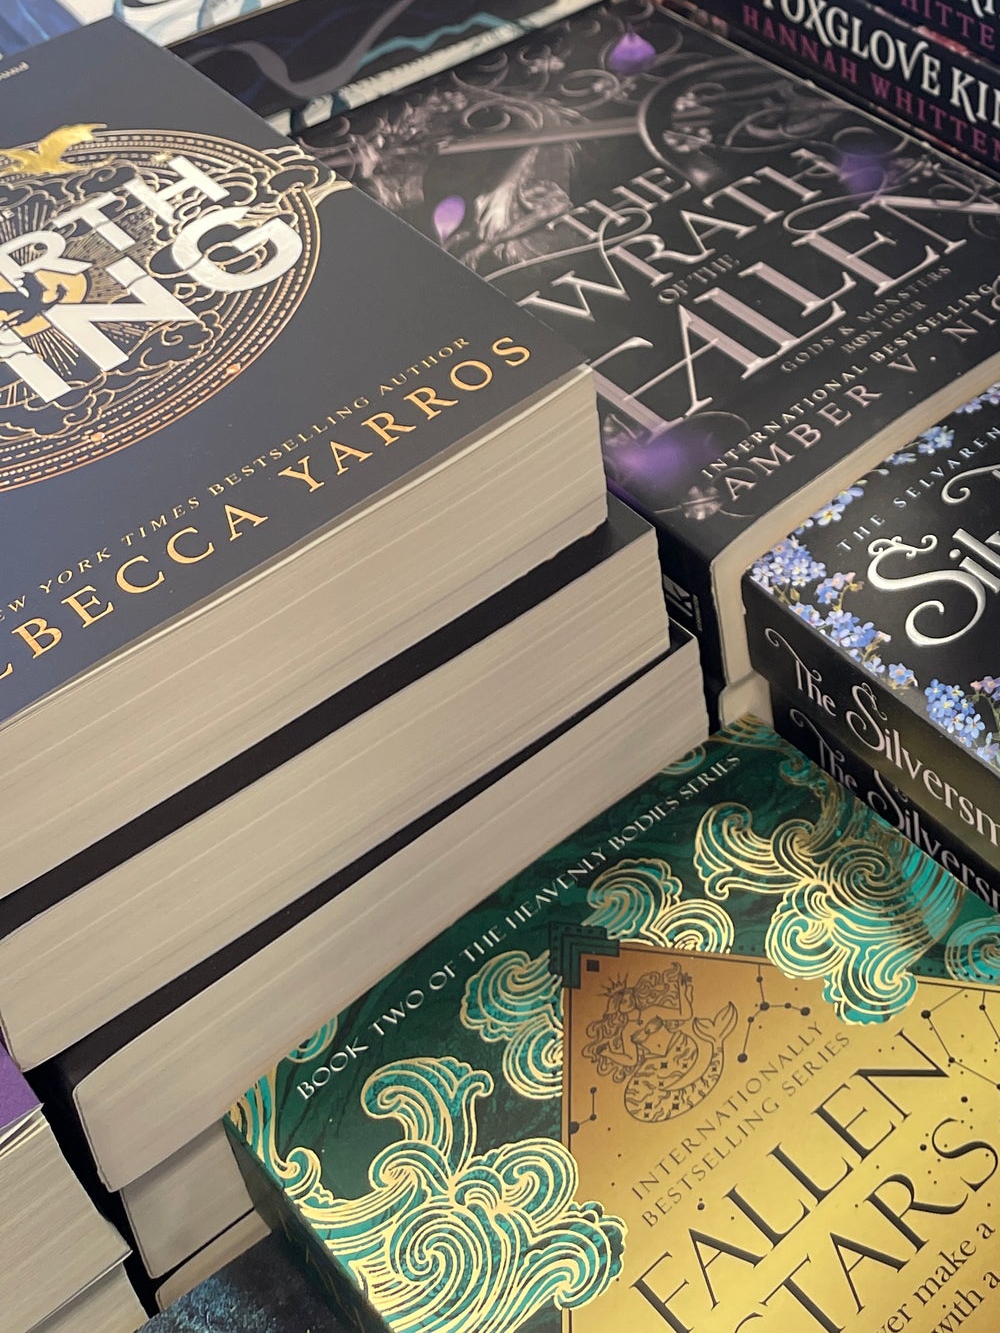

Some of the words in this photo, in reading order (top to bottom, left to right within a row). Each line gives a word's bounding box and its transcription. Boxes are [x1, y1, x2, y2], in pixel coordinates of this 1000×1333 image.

[742, 3, 858, 85] HANNAH
[545, 166, 692, 243] THE
[656, 278, 689, 305] OF
[781, 336, 835, 373] GODS
[857, 265, 952, 323] MONSTERS
[841, 326, 883, 355] BOOK
[881, 299, 927, 329] FOUR
[277, 334, 532, 494] YARROS
[700, 363, 869, 480] INTERNATIONAL
[869, 282, 994, 363] BESTSELLING
[40, 546, 112, 595] YORK
[120, 495, 201, 548] TIMES
[207, 396, 370, 498] BESTSELLING
[378, 336, 470, 398] AUTHOR
[723, 383, 883, 502] AMBER
[836, 514, 887, 553] THE
[765, 628, 837, 717] The
[790, 709, 859, 790] The
[296, 1035, 370, 1102] BOOK
[367, 988, 426, 1037] TWO
[427, 959, 459, 992] OF
[458, 925, 507, 965] THE
[504, 845, 609, 932] HEAVENLY
[607, 793, 681, 853] BODIES
[678, 754, 742, 801] SERIES
[631, 1020, 825, 1202] INTERNATIONALLY
[640, 1096, 781, 1230] BESTSELLING
[783, 1031, 852, 1098] SERIES
[629, 1028, 950, 1333] FALLEN
[735, 1116, 1000, 1333] TARS
[911, 1238, 978, 1307] make
[975, 1221, 997, 1240] a
[931, 1288, 986, 1333] with
